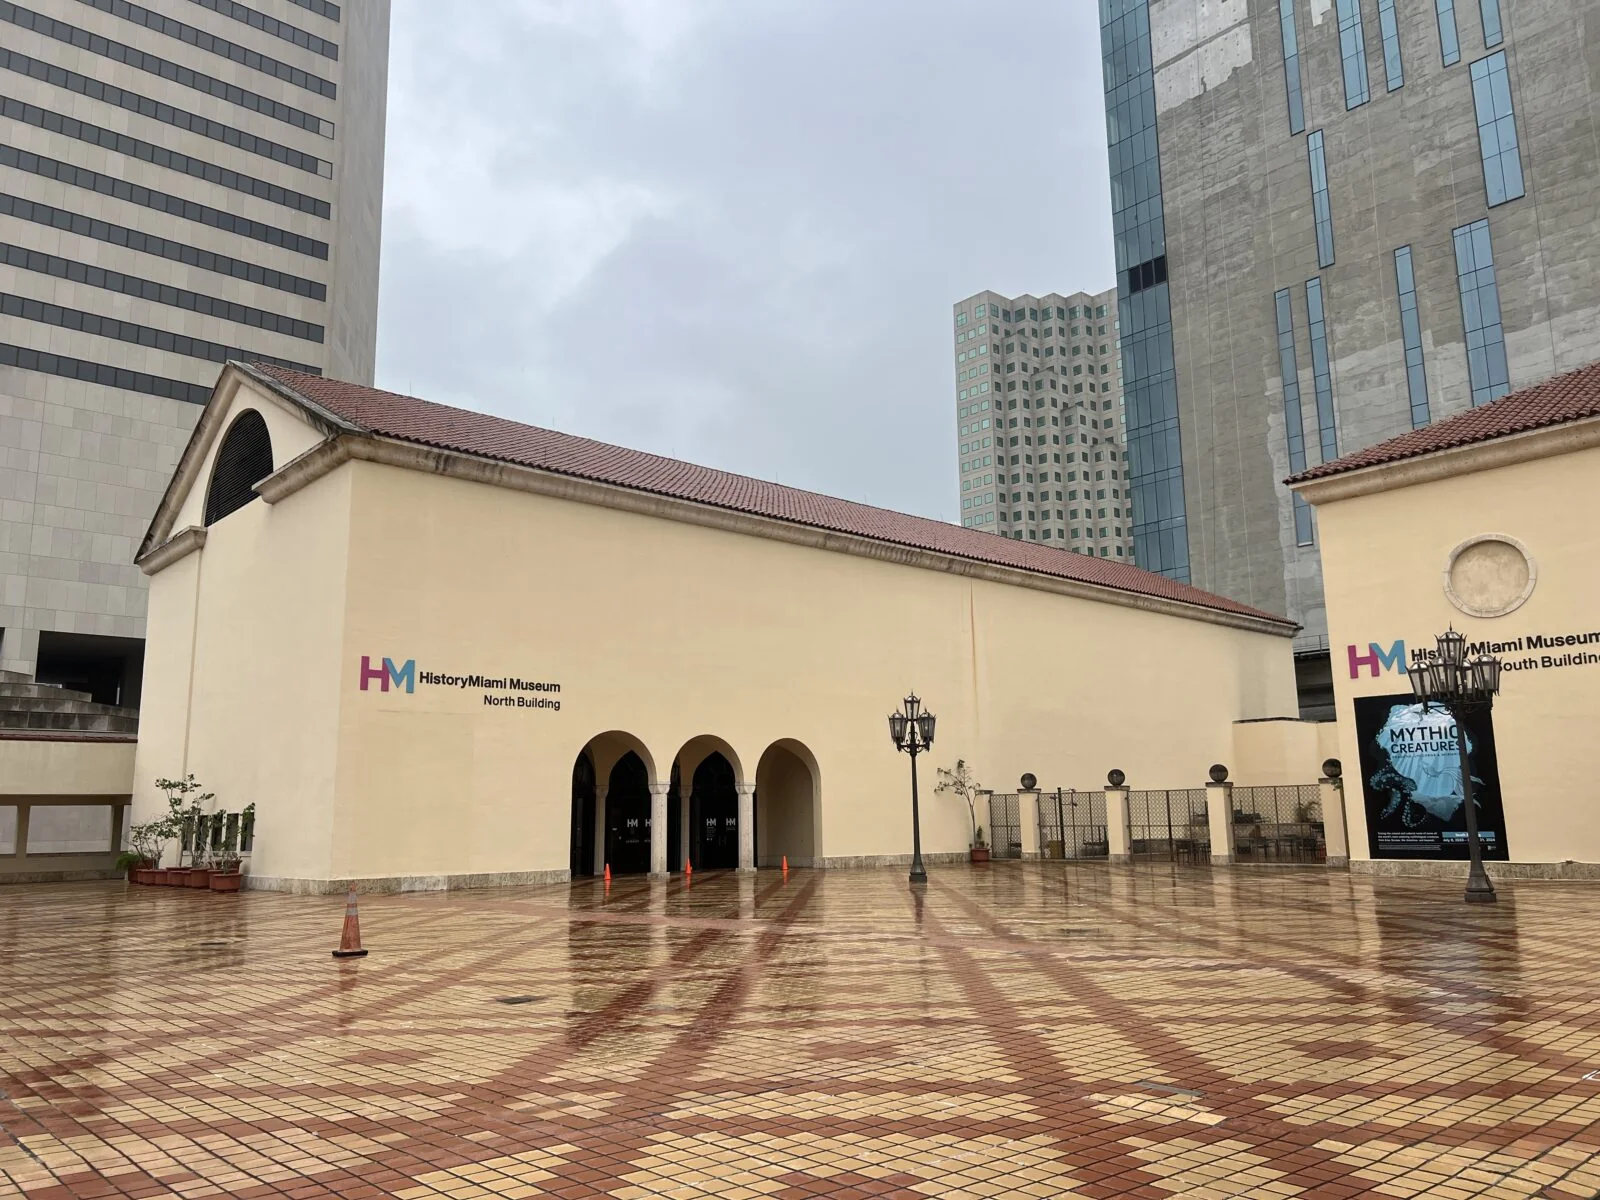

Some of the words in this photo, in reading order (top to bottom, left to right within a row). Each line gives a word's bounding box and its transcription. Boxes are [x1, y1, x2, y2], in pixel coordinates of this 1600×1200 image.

[1347, 640, 1406, 679] HM
[1411, 637, 1523, 661] HisyMiami
[1541, 652, 1600, 668] Buildin
[360, 656, 415, 694] HM
[419, 671, 507, 689] HistoryMiami
[509, 678, 561, 693] Museum
[483, 695, 515, 707] North
[517, 697, 561, 711] Building
[627, 818, 638, 827] HM
